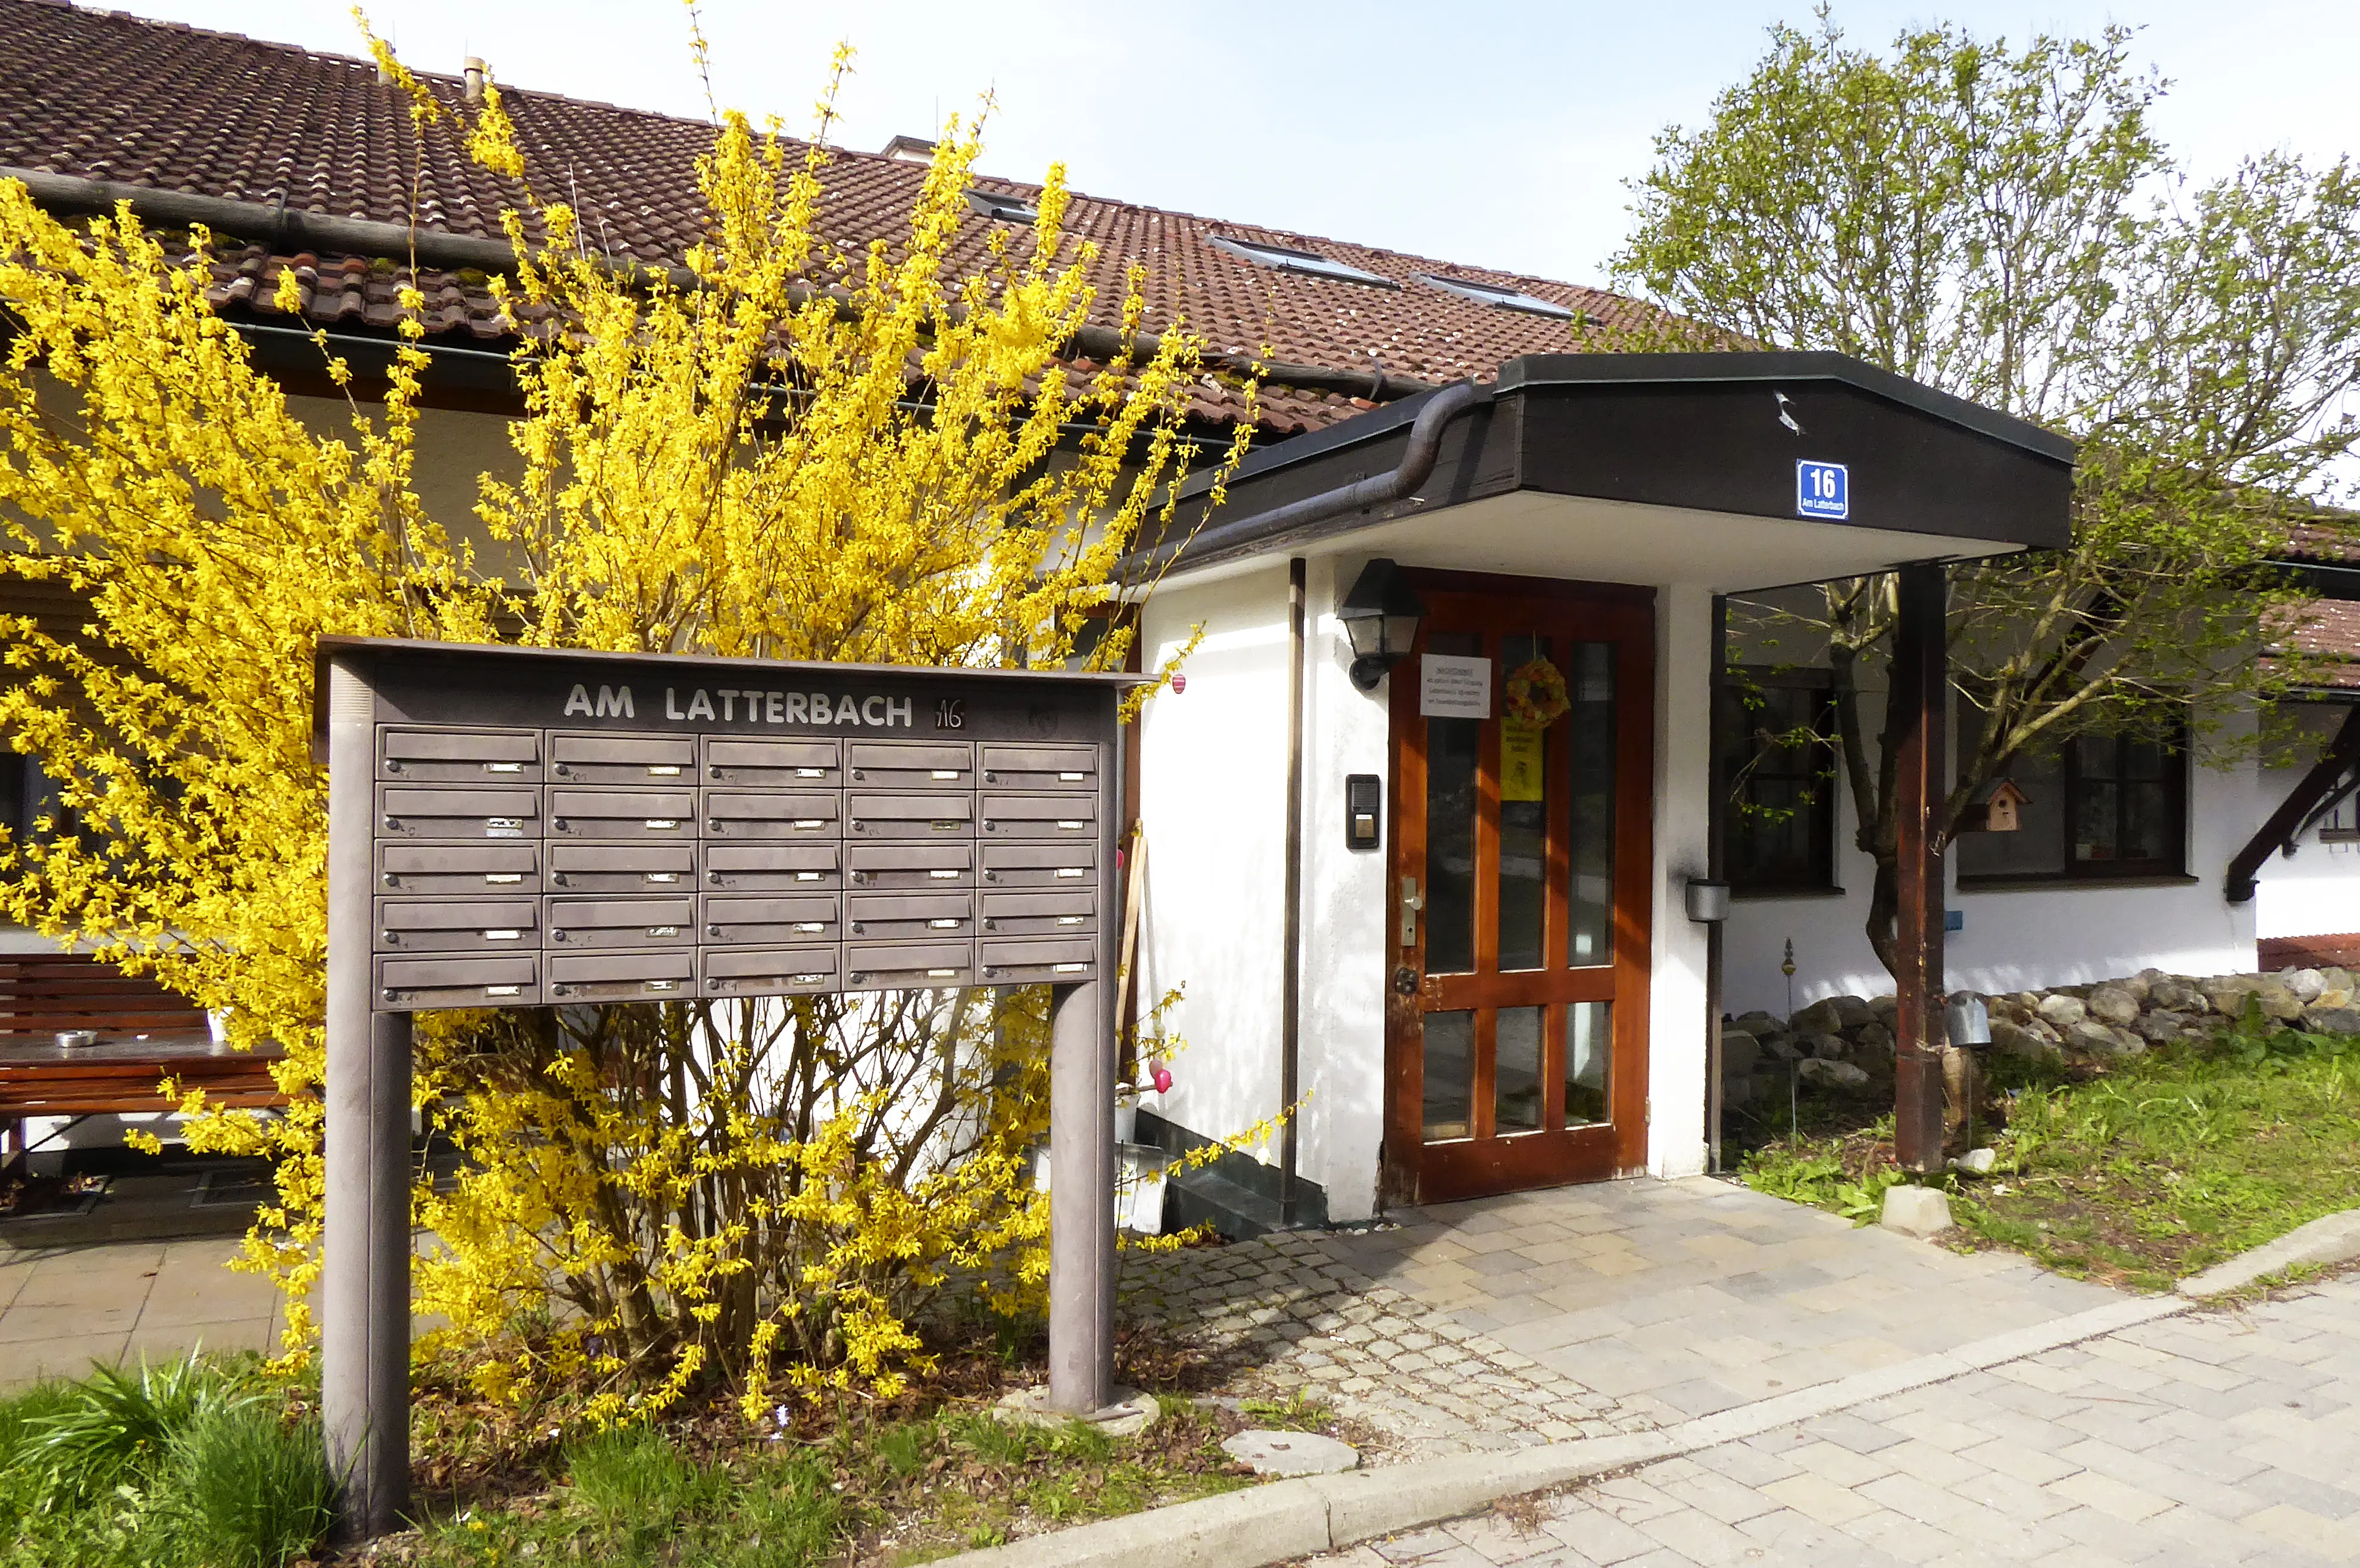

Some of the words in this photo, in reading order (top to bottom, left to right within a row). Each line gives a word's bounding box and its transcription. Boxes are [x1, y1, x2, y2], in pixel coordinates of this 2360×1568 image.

[1810, 468, 1835, 498] 16
[564, 684, 635, 719] AM
[666, 687, 912, 727] LATTERBACH
[937, 699, 962, 727] 16
